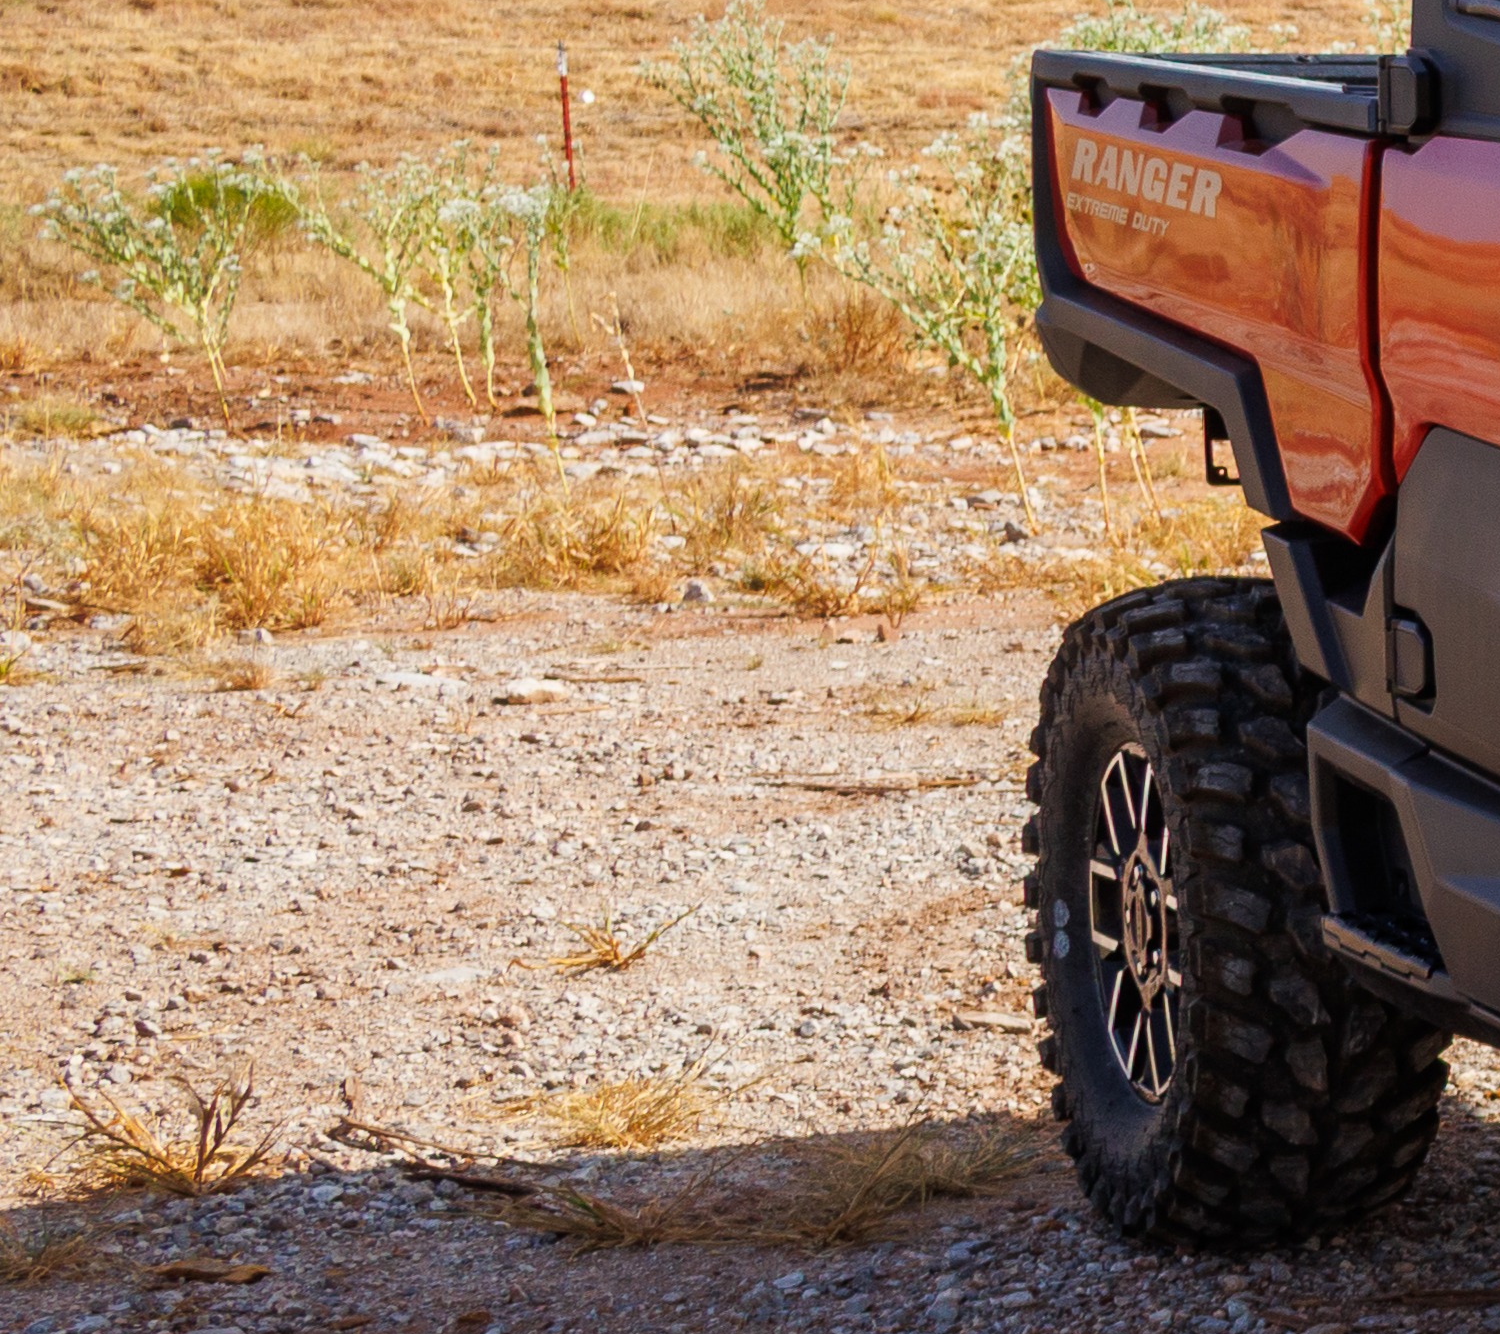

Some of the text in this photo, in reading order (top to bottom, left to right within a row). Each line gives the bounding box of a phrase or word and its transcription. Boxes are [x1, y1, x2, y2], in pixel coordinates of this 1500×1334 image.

[1071, 138, 1223, 218] RANGER
[1066, 192, 1170, 236] EXTREME DUTY
